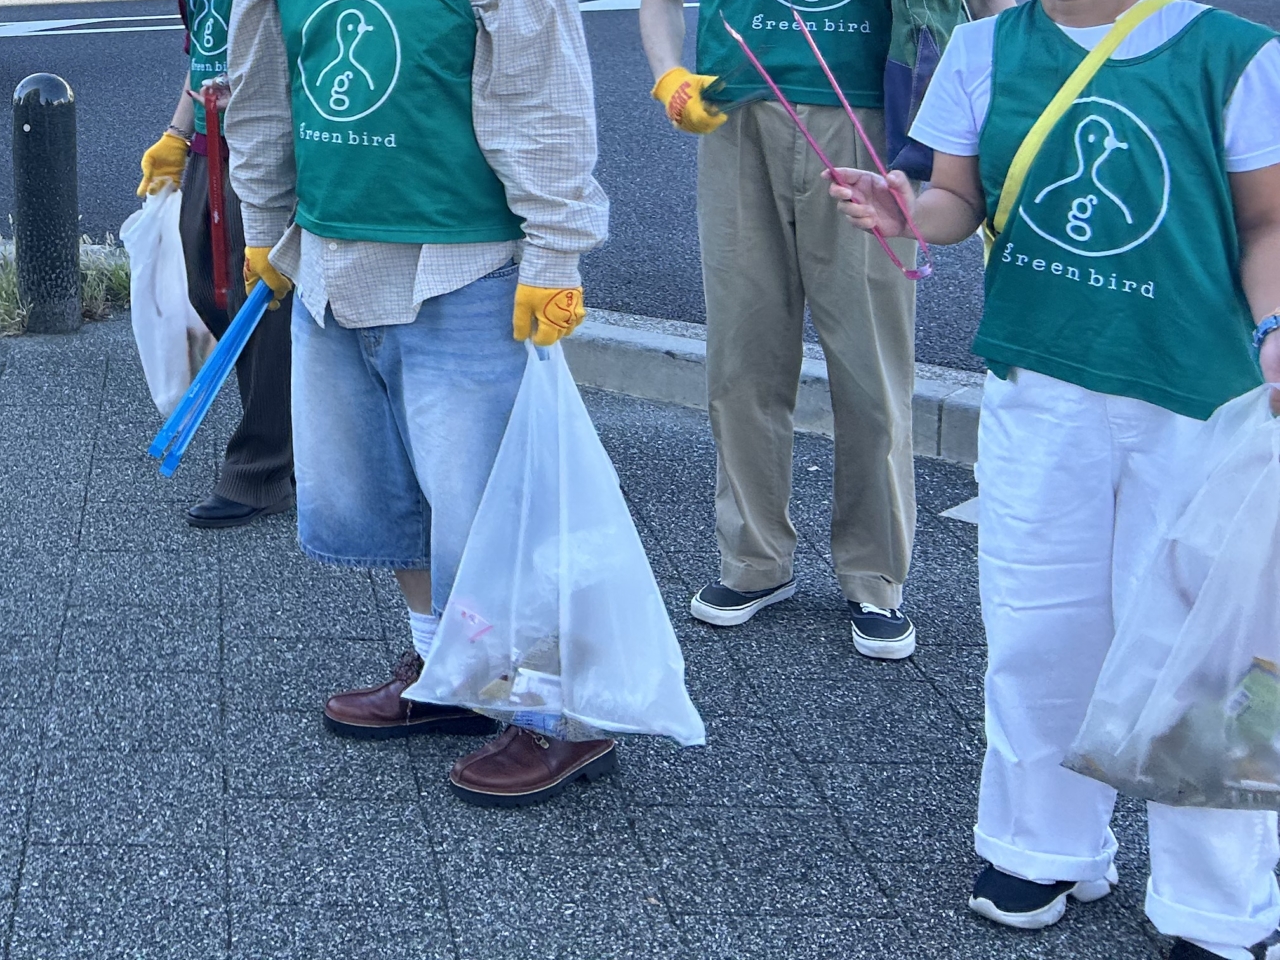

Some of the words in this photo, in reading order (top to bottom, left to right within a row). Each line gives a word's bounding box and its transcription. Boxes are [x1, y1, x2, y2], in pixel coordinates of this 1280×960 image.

[751, 13, 818, 32] green
[824, 15, 872, 33] bird
[214, 61, 227, 72] bi
[347, 130, 397, 148] bird
[1001, 243, 1080, 282] green
[1088, 268, 1155, 299] bird
